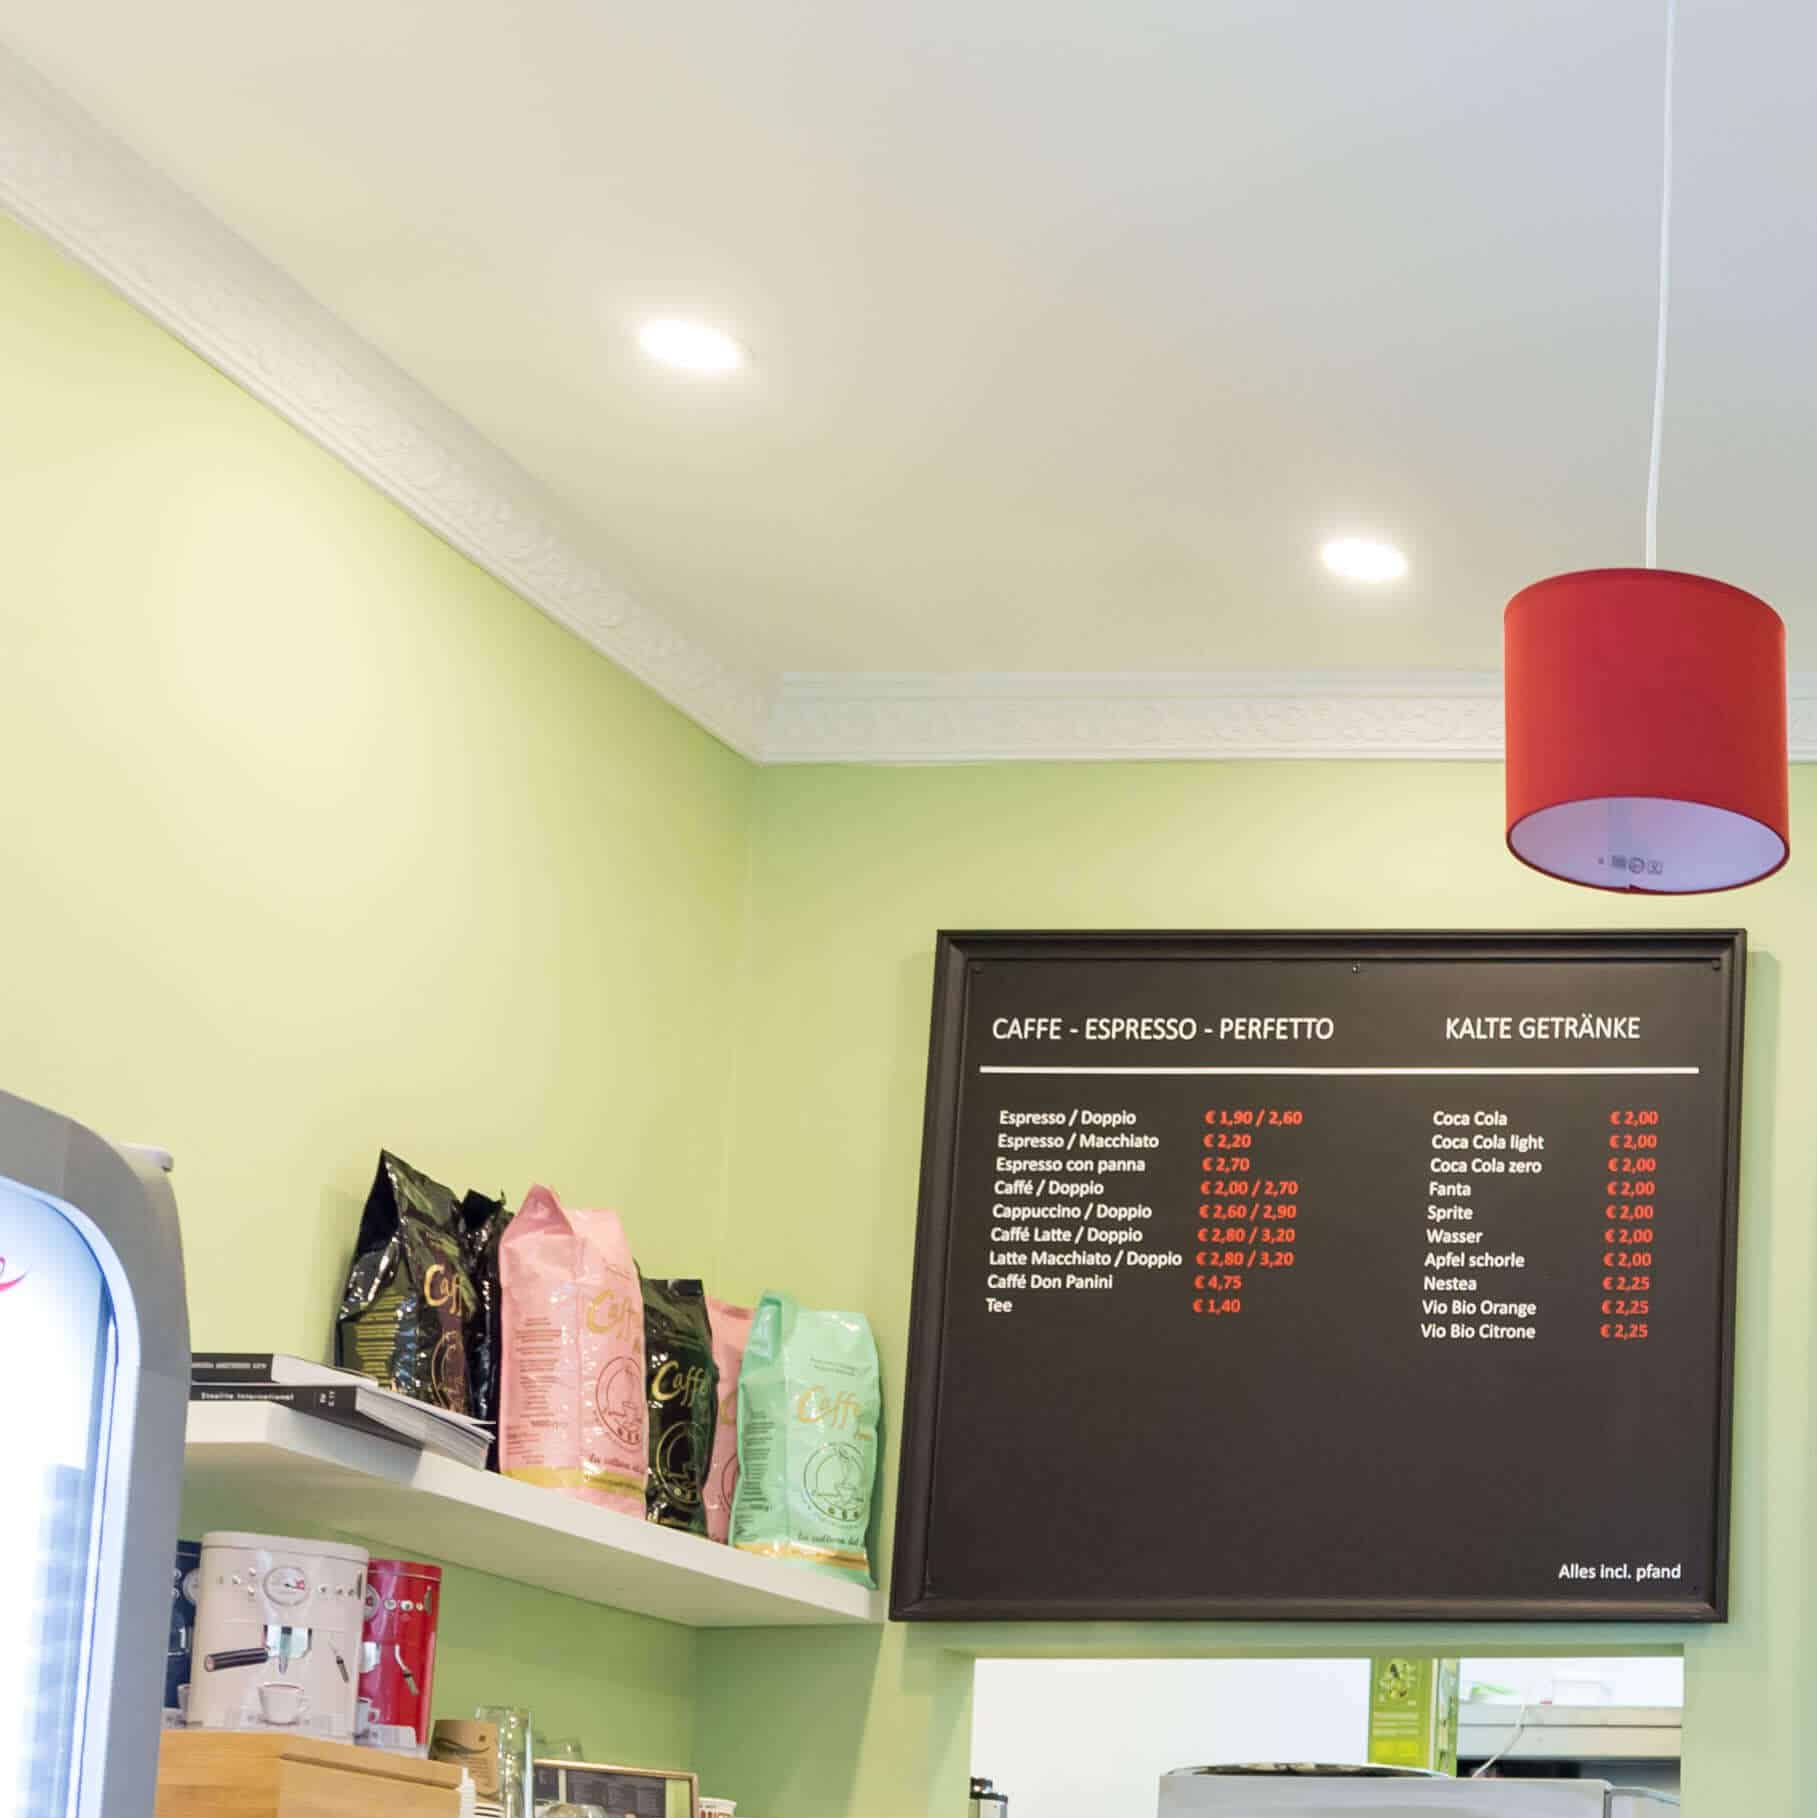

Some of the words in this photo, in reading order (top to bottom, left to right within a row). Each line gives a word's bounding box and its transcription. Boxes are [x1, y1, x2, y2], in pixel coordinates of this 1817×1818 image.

[992, 1017, 1063, 1040] CAFFE
[1085, 1017, 1197, 1041] ESPRESSO
[1219, 1017, 1335, 1040] PERFETTO
[1445, 1016, 1513, 1040] KALTE
[1518, 1012, 1641, 1040] GETRÄNKE
[999, 1109, 1067, 1128] Espresso
[1080, 1109, 1137, 1128] Doppio
[1432, 1110, 1471, 1127] Coca
[1473, 1109, 1508, 1127] Cola
[997, 1133, 1065, 1151] Espresso
[1079, 1132, 1160, 1149] Macchiato
[1431, 1134, 1469, 1150] Coca
[1472, 1133, 1507, 1150] Cola
[1510, 1133, 1545, 1153] light
[996, 1156, 1063, 1175] Espresso
[1065, 1159, 1094, 1172] con
[1097, 1159, 1146, 1175] panna
[1430, 1157, 1468, 1173] Coca
[1471, 1157, 1505, 1173] Cola
[1508, 1161, 1543, 1174] zero
[1048, 1179, 1105, 1198] Doppio
[1429, 1180, 1472, 1197] Fanta
[992, 1203, 1082, 1222] Cappuccino
[1096, 1203, 1153, 1222] Doppio
[1427, 1204, 1474, 1223] Sprite
[1033, 1227, 1073, 1242] Latte
[1087, 1226, 1144, 1245] Doppio
[1425, 1228, 1484, 1244] Wasser
[989, 1250, 1028, 1266] Latte
[1031, 1250, 1112, 1266] Macchiato
[1126, 1250, 1183, 1269] Doppio
[1423, 1251, 1466, 1271] Apfel
[1468, 1251, 1525, 1268] schorle
[1030, 1273, 1062, 1289] Don
[1065, 1273, 1113, 1289] Panini
[1423, 1275, 1478, 1291] Nestea
[985, 1297, 1013, 1313] Tee
[1421, 1299, 1448, 1315] Vio
[1451, 1299, 1477, 1315] Bio
[1479, 1299, 1537, 1319] Orange
[1420, 1323, 1447, 1339] Vio
[1450, 1323, 1476, 1339] Bio
[1478, 1323, 1536, 1339] Citrone
[1558, 1563, 1597, 1579] Alles
[1599, 1563, 1632, 1579] incl.
[1635, 1563, 1682, 1582] pfand
